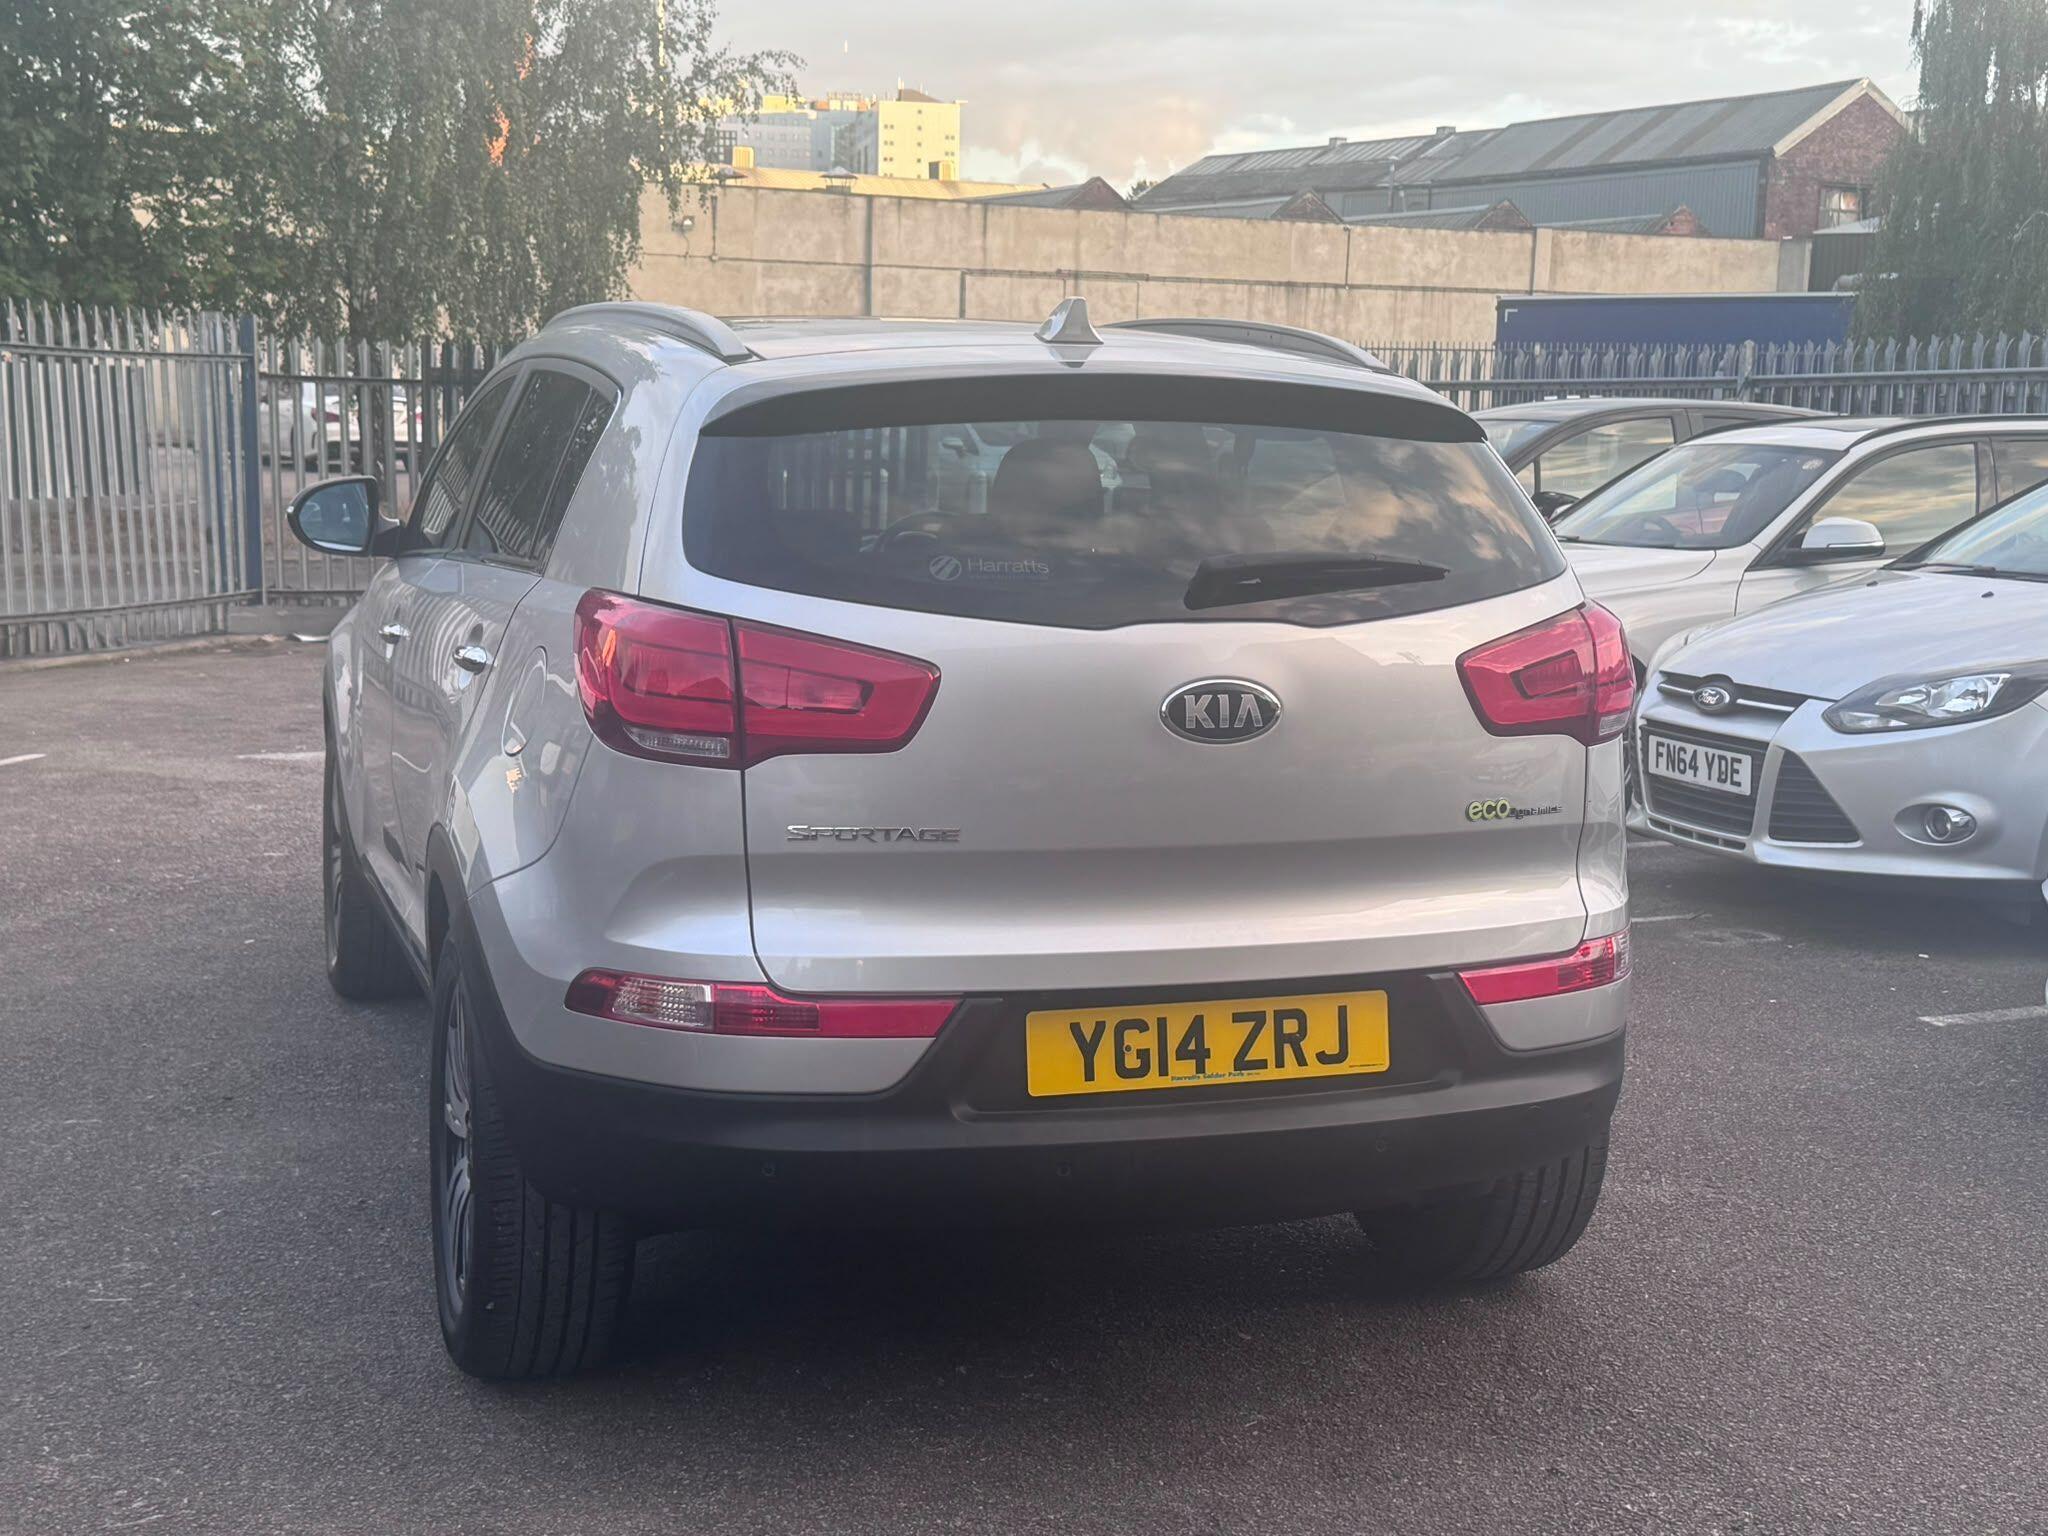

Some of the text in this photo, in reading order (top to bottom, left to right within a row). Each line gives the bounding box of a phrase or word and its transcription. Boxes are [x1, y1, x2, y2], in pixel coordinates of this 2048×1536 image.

[968, 557, 1049, 574] Harratts
[1184, 693, 1263, 729] KIA
[1655, 740, 1743, 788] FN64 YDE
[787, 825, 960, 842] SPORTAGE
[1069, 1004, 1350, 1082] YG14 ZRJ
